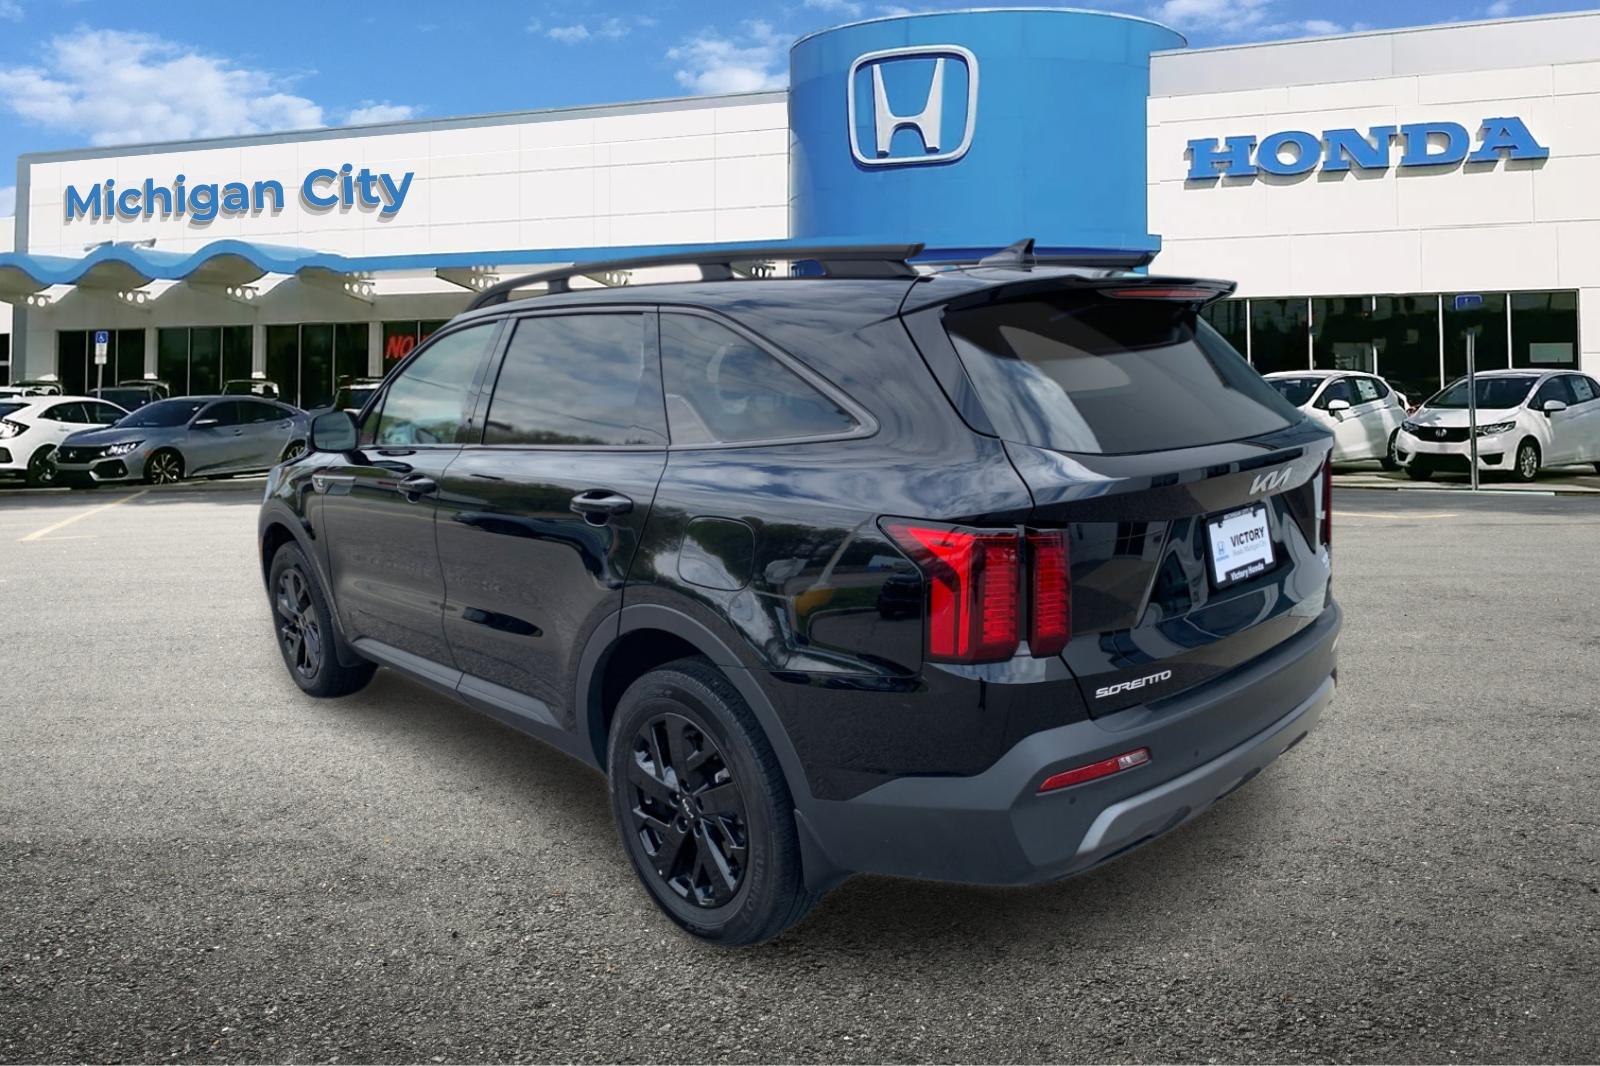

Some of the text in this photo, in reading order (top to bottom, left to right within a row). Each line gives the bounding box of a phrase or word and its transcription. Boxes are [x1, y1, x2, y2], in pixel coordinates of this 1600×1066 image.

[1185, 116, 1549, 184] HONDA
[66, 163, 415, 223] Michigan City
[1231, 527, 1265, 547] VICTORY
[1096, 670, 1172, 698] SORENTO
